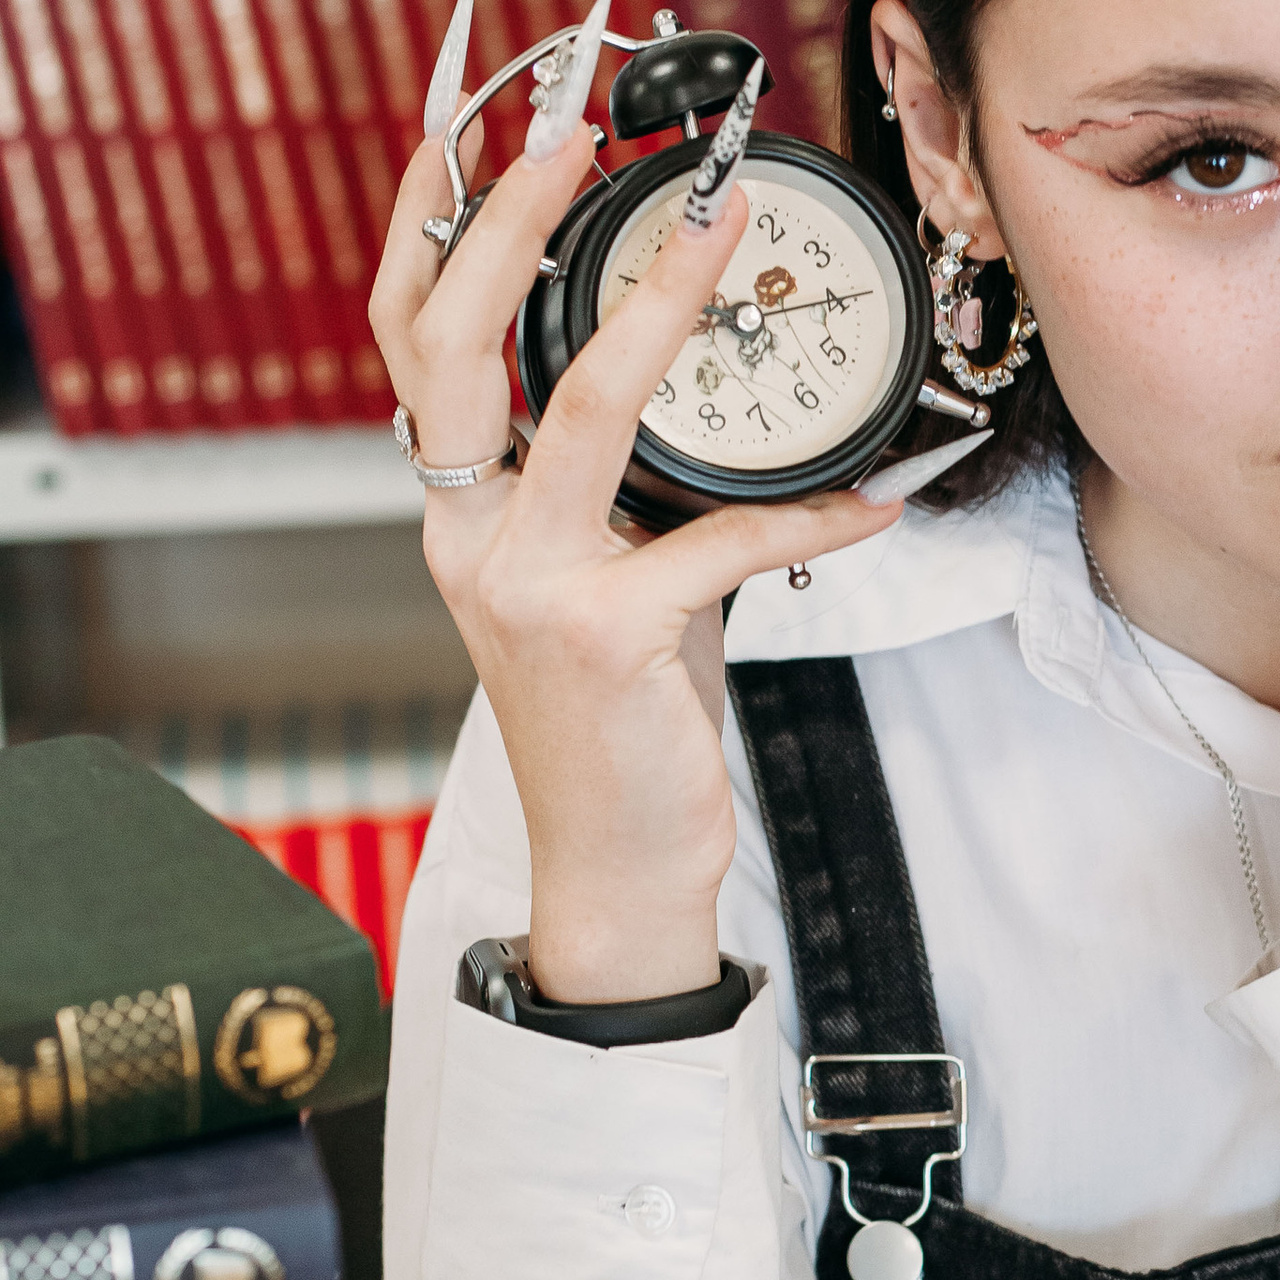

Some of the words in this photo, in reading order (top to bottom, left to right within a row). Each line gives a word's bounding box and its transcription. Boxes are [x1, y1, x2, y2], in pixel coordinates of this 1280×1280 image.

[757, 213, 786, 244] 2
[803, 240, 831, 269] 3
[826, 286, 850, 315] 4
[820, 336, 847, 367] 5
[653, 377, 677, 405] 9
[794, 382, 820, 410] 6
[698, 402, 726, 432] 8
[746, 401, 772, 433] 7
